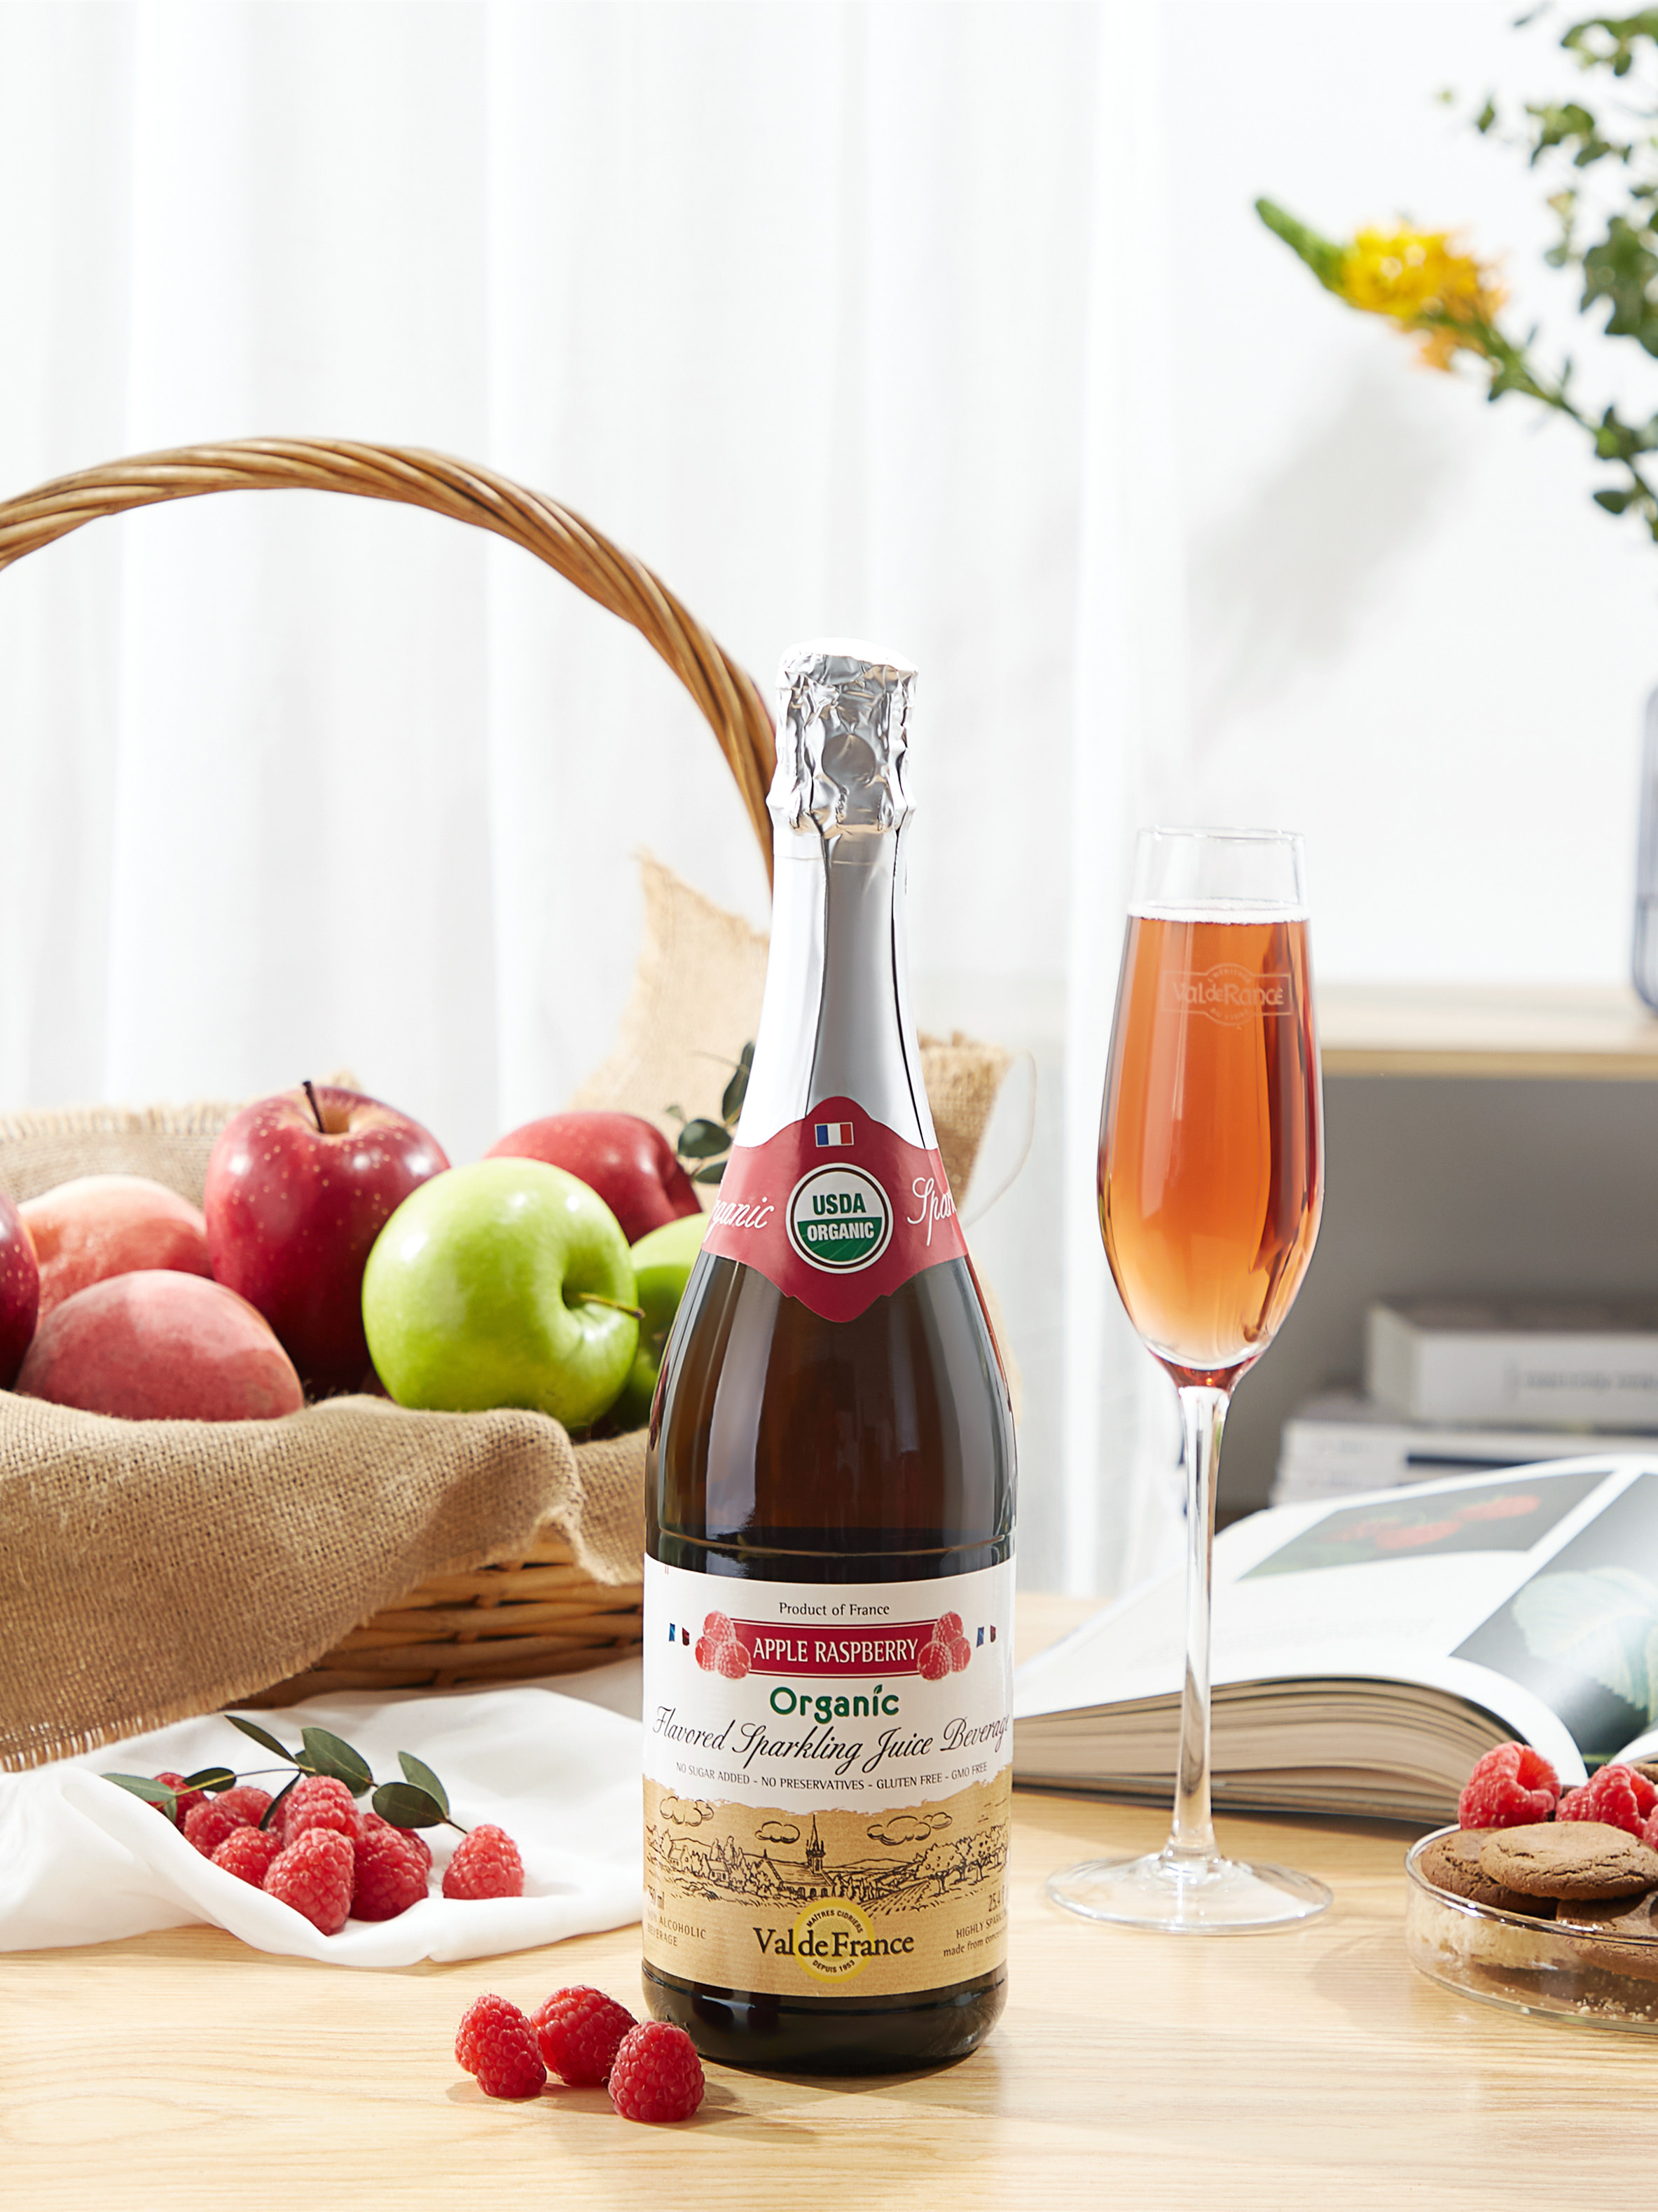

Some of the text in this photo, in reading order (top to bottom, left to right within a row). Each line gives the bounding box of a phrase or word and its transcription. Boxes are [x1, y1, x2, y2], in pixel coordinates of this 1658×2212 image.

[813, 1193, 866, 1216] USDA
[807, 1221, 875, 1242] ORGANIC
[779, 1602, 890, 1616] Product of France
[753, 1637, 918, 1663] APPLE RASPBERRY
[770, 1684, 899, 1724] Organic
[652, 1705, 736, 1750] Flavored
[731, 1722, 864, 1775] Sparkling
[862, 1726, 933, 1773] Juice
[676, 1761, 686, 1773] NO
[688, 1764, 715, 1780] SUGAR
[717, 1771, 750, 1785] ADDED
[761, 1776, 777, 1787] NO
[780, 1778, 864, 1790] PRESERVATIVES
[876, 1776, 918, 1789] GLUTEN
[920, 1773, 943, 1785] FREE
[951, 1767, 970, 1780] GMO
[972, 1761, 988, 1775] FREE
[659, 1915, 707, 1940] ALCOHOLIC
[806, 1909, 864, 1934] MAÎTRES CIDRIERS
[956, 1921, 984, 1939] HIGHLY
[943, 1944, 965, 1957] made
[967, 1939, 983, 1951] from
[813, 1959, 856, 1973] DEPUIS 1953
